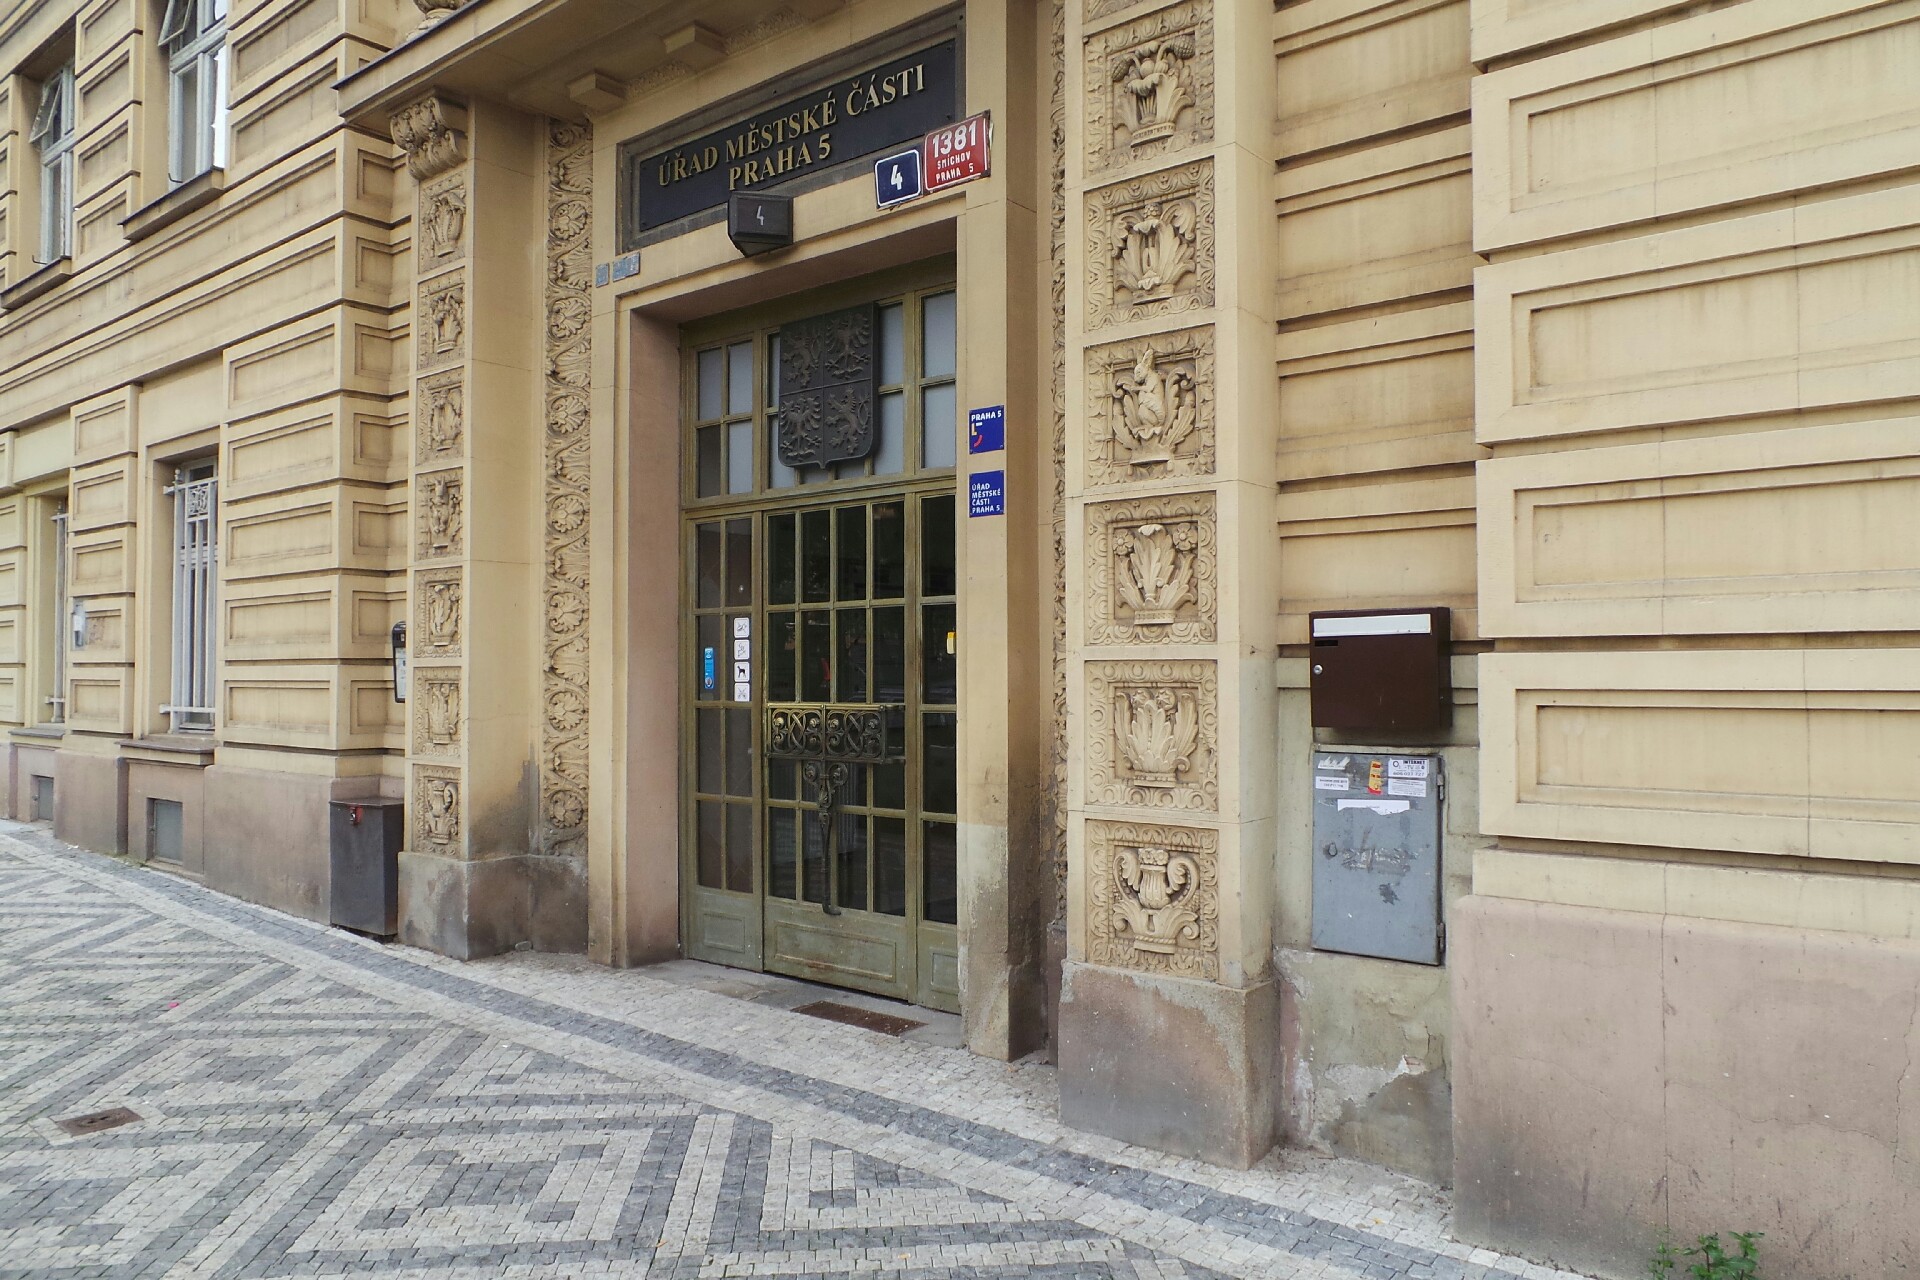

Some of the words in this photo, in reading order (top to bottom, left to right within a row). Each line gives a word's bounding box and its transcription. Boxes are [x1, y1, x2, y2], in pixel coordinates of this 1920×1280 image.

[658, 146, 718, 186] ÚŘAD
[725, 91, 837, 163] MĚSTSKÉ
[846, 64, 925, 116] ČÁSTI
[932, 120, 977, 158] 1381
[728, 142, 813, 191] PRAHA
[818, 132, 831, 159] 5
[937, 151, 971, 170] SMÍCHOV
[890, 164, 903, 190] 4
[935, 167, 961, 183] PRAHA
[968, 162, 974, 173] 5
[756, 205, 764, 226] 4
[971, 411, 996, 422] PRAHA
[997, 410, 1002, 418] 5
[971, 482, 990, 491] ÚŘAD
[971, 487, 1001, 500] MĚSTSKÉ
[972, 497, 990, 506] ČÁSTI
[972, 505, 995, 514] PRAHA
[996, 504, 1001, 512] 5
